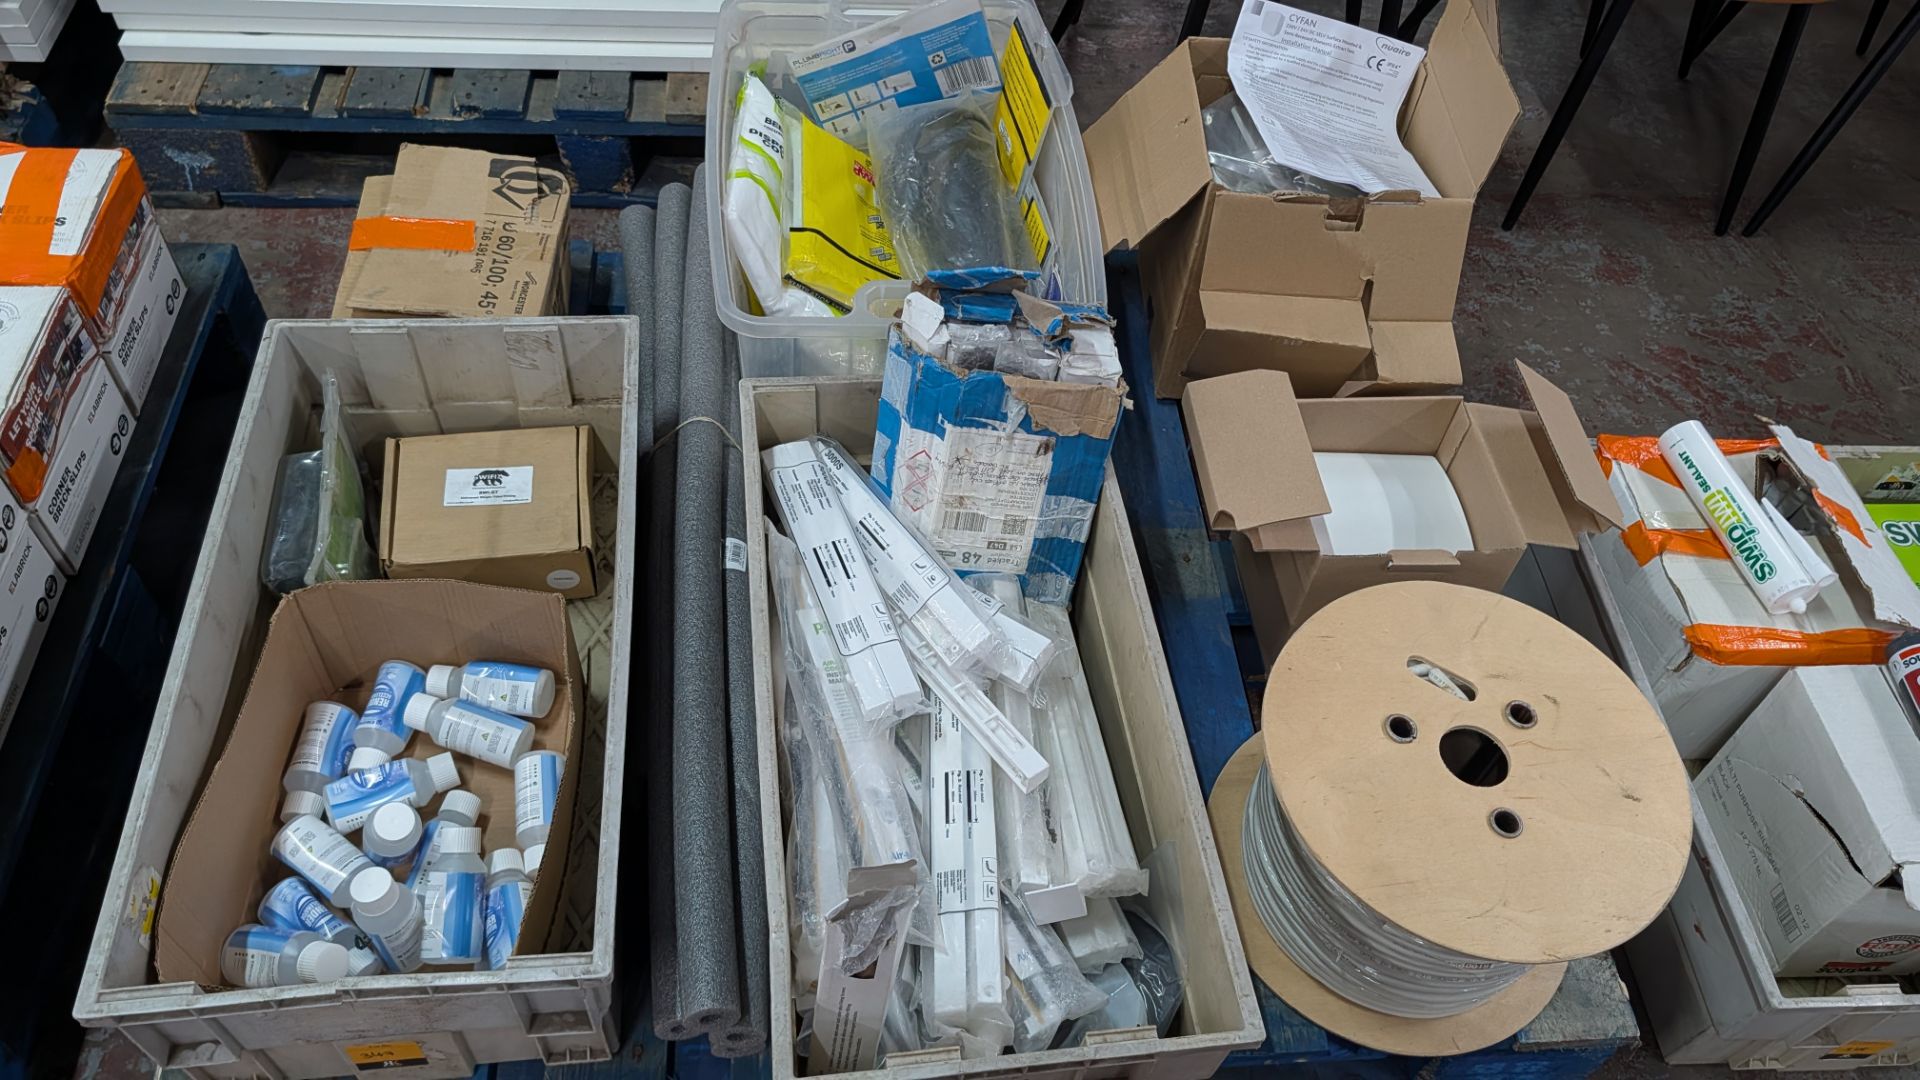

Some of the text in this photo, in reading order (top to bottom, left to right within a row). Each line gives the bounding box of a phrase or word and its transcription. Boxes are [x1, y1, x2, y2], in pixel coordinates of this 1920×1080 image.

[1288, 13, 1317, 28] CYFAN
[1280, 37, 1311, 51] Installation
[1380, 41, 1412, 58] nuaire
[476, 243, 489, 257] 191
[481, 227, 494, 241] 716
[514, 280, 530, 315] WORCESTER
[117, 316, 138, 359] CORNER
[121, 304, 149, 368] BRICK SLIPS
[87, 381, 109, 425] ELABRICK
[825, 450, 844, 470] 3000S
[1678, 451, 1711, 492] SEALANT
[47, 466, 72, 516] CORNER
[52, 450, 88, 524] BRICK SLIPS
[8, 544, 33, 596] ELABRICK
[962, 552, 1020, 567] Tracked 48
[1735, 783, 1760, 831] PURPOSE
